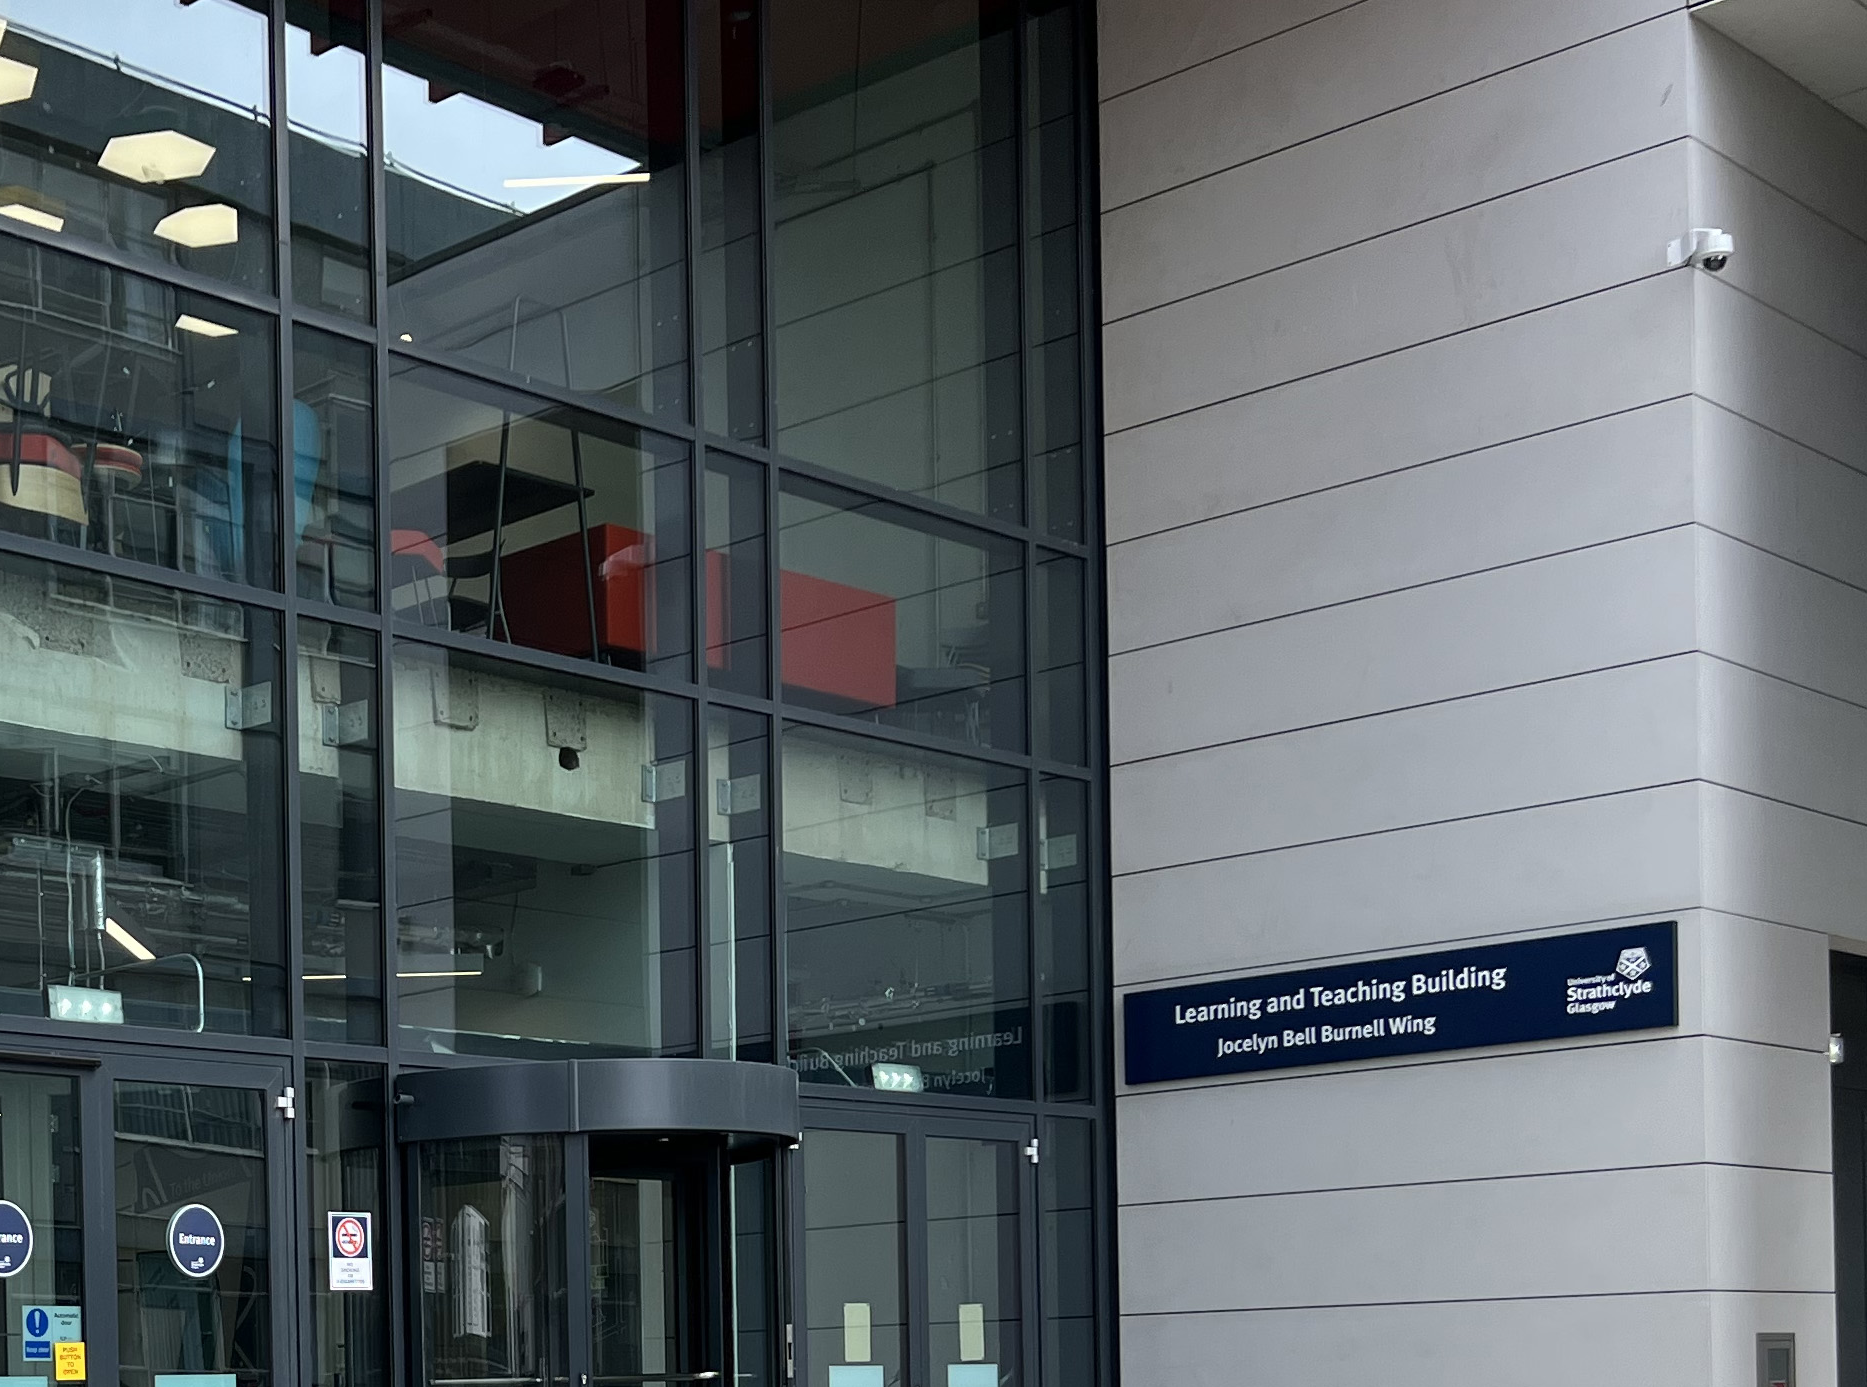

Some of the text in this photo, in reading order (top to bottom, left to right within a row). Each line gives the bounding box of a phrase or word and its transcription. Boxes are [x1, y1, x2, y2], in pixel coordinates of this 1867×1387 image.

[1175, 966, 1508, 1025] Learning and Teaching Building
[1566, 980, 1652, 1002] Strathclyde
[1566, 1000, 1617, 1014] Glasgow
[1217, 1015, 1436, 1057] Jocelyn Bell Burnell Wing
[178, 1232, 216, 1247] Entrance
